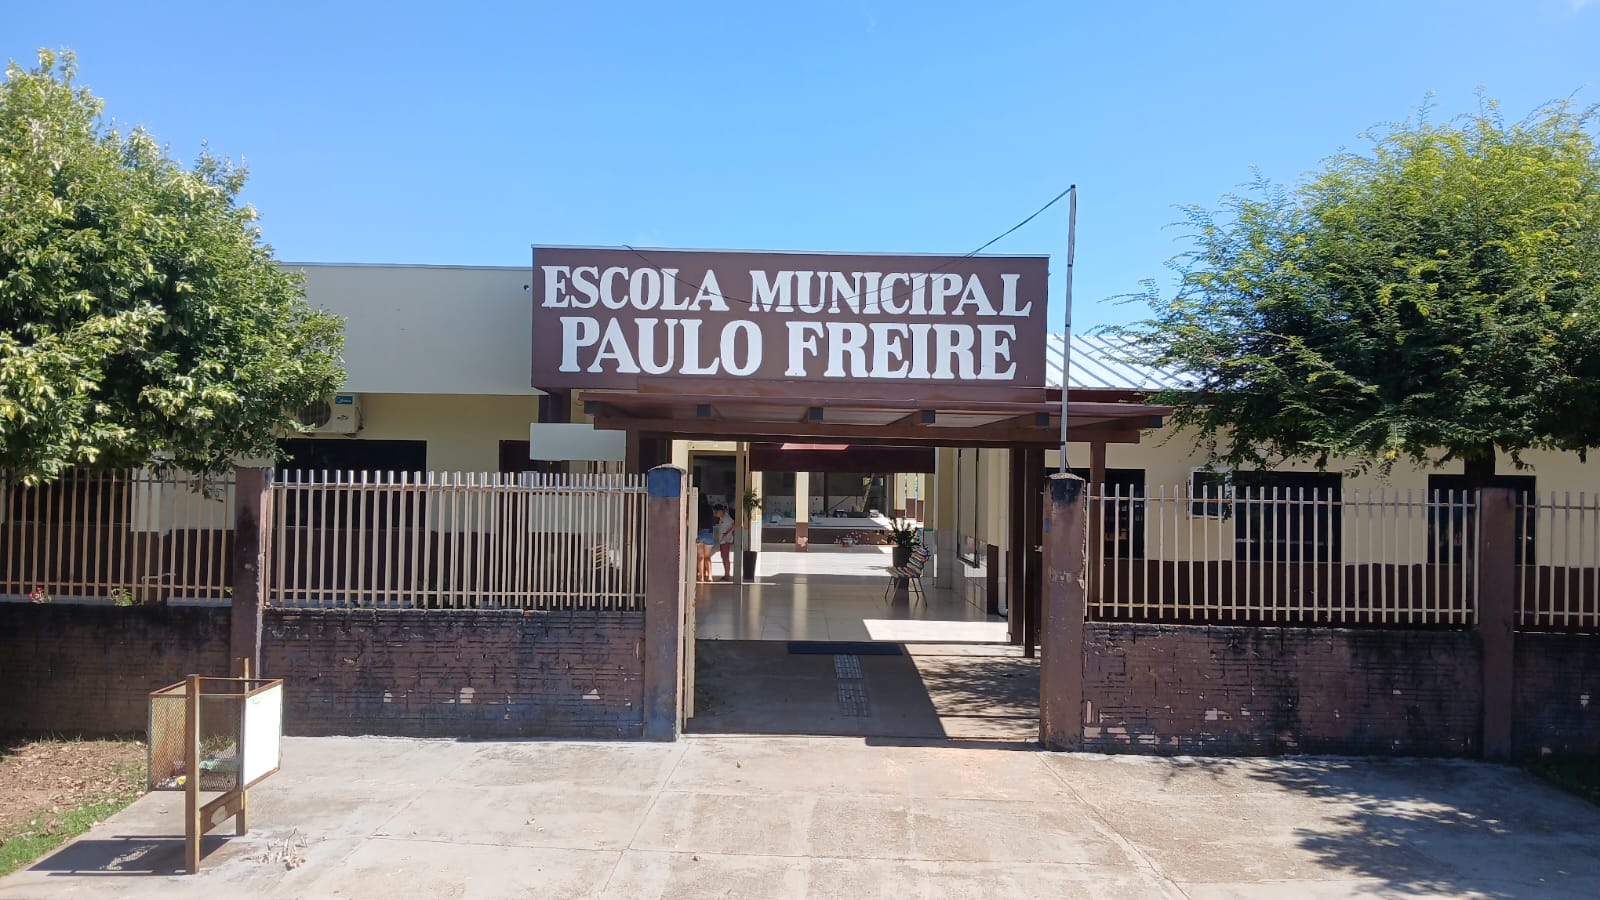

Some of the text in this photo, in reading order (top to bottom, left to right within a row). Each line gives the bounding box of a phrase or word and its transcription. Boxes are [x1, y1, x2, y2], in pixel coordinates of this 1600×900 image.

[541, 265, 1032, 317] ESCOLA MUNICIPAL
[558, 316, 1017, 380] PAULO FREIRE
